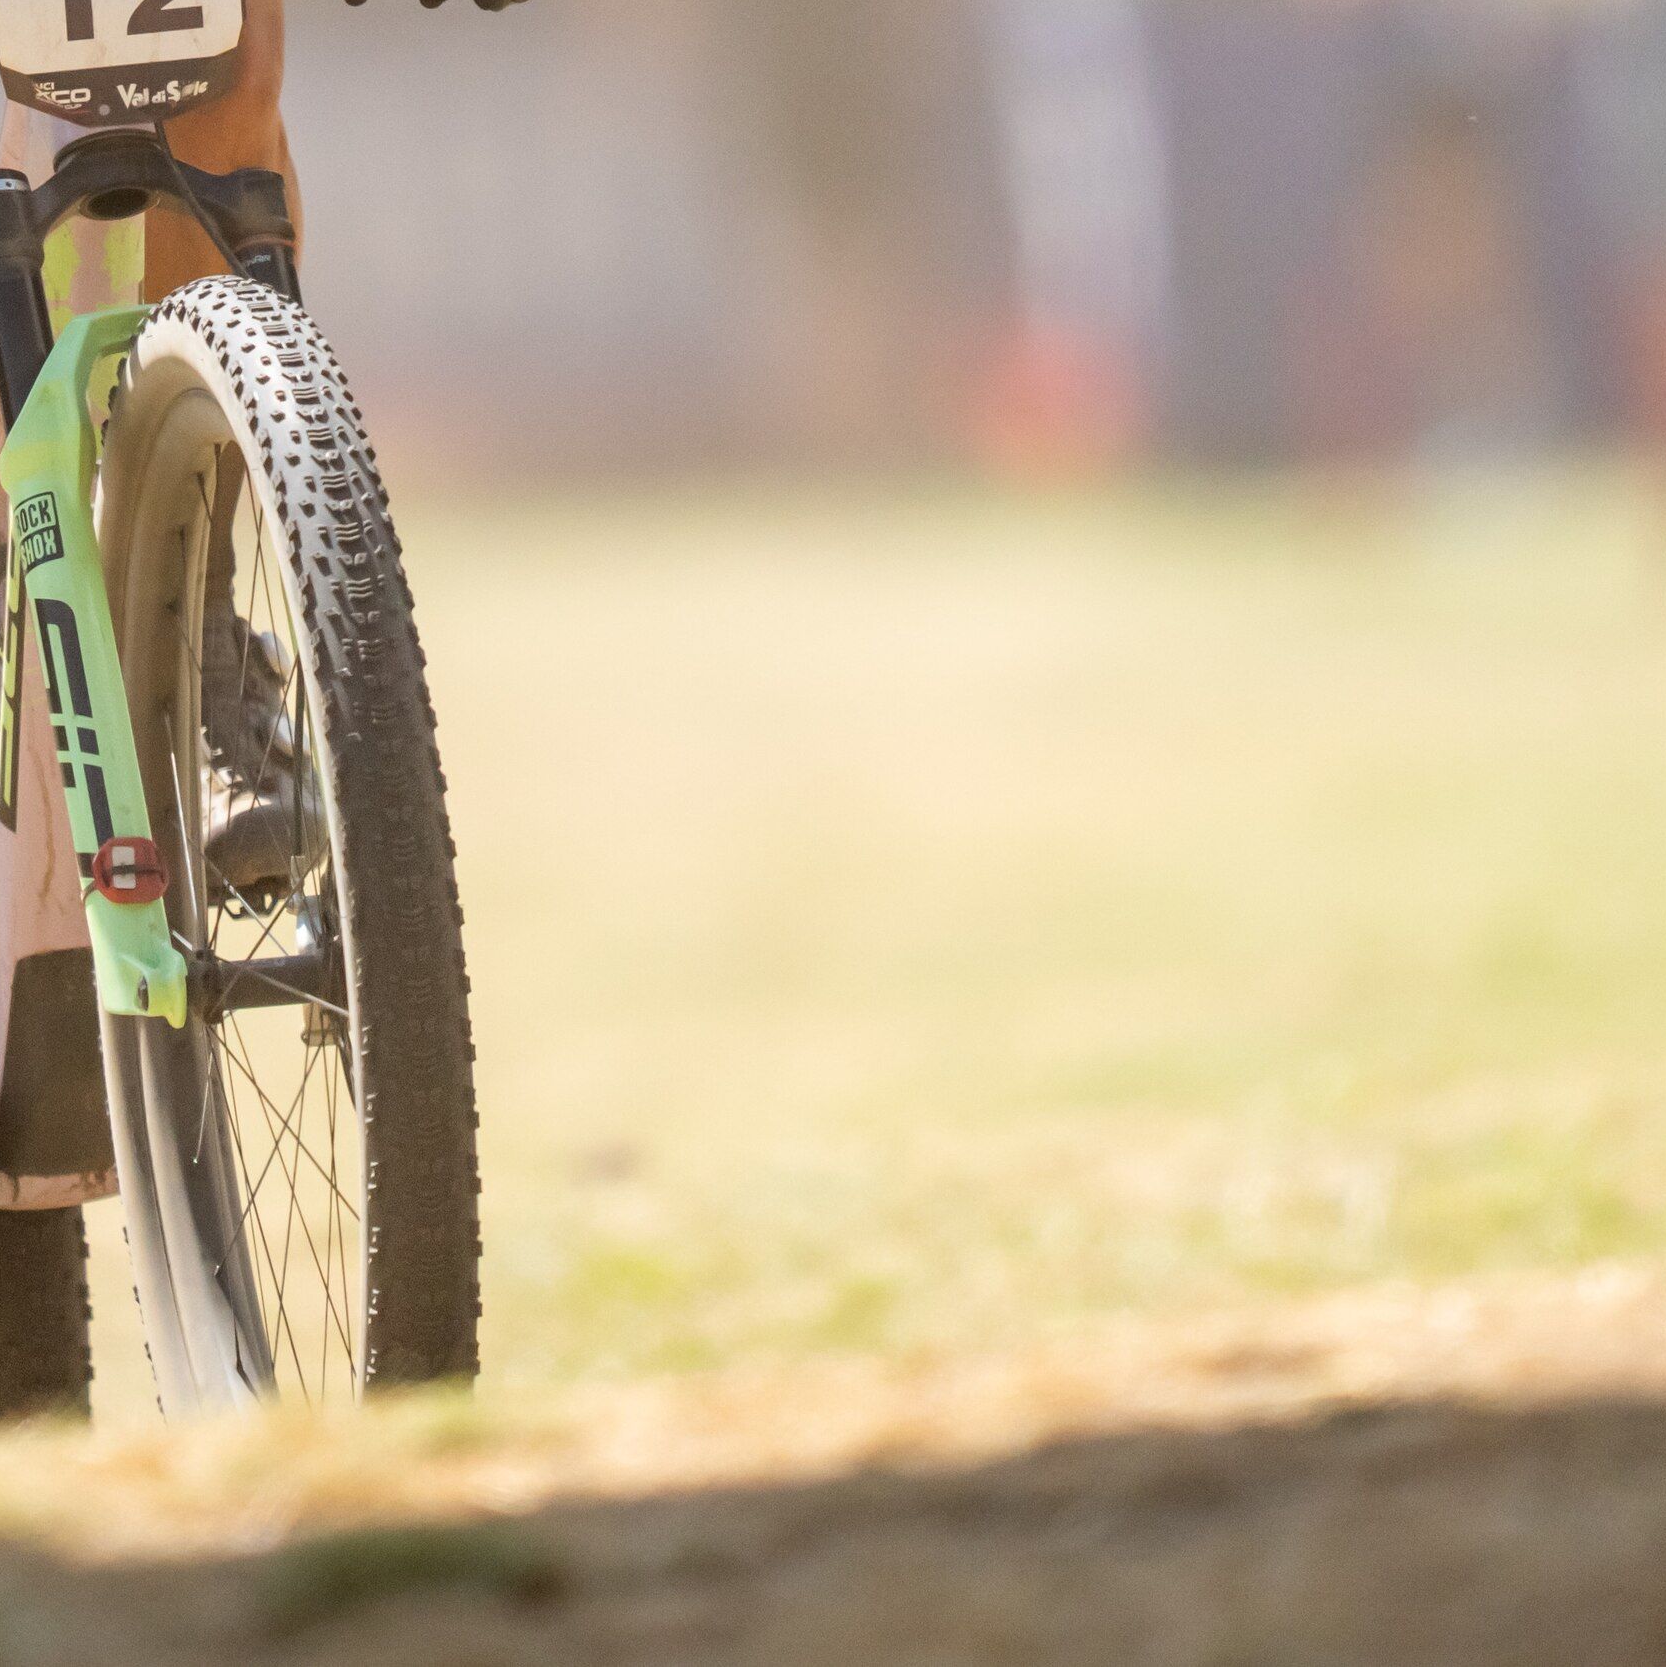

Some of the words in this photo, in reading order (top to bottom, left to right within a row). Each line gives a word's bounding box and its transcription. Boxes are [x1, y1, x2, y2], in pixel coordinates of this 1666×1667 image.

[116, 83, 149, 109] Val
[166, 80, 209, 103] Sle
[15, 499, 52, 536] OCK
